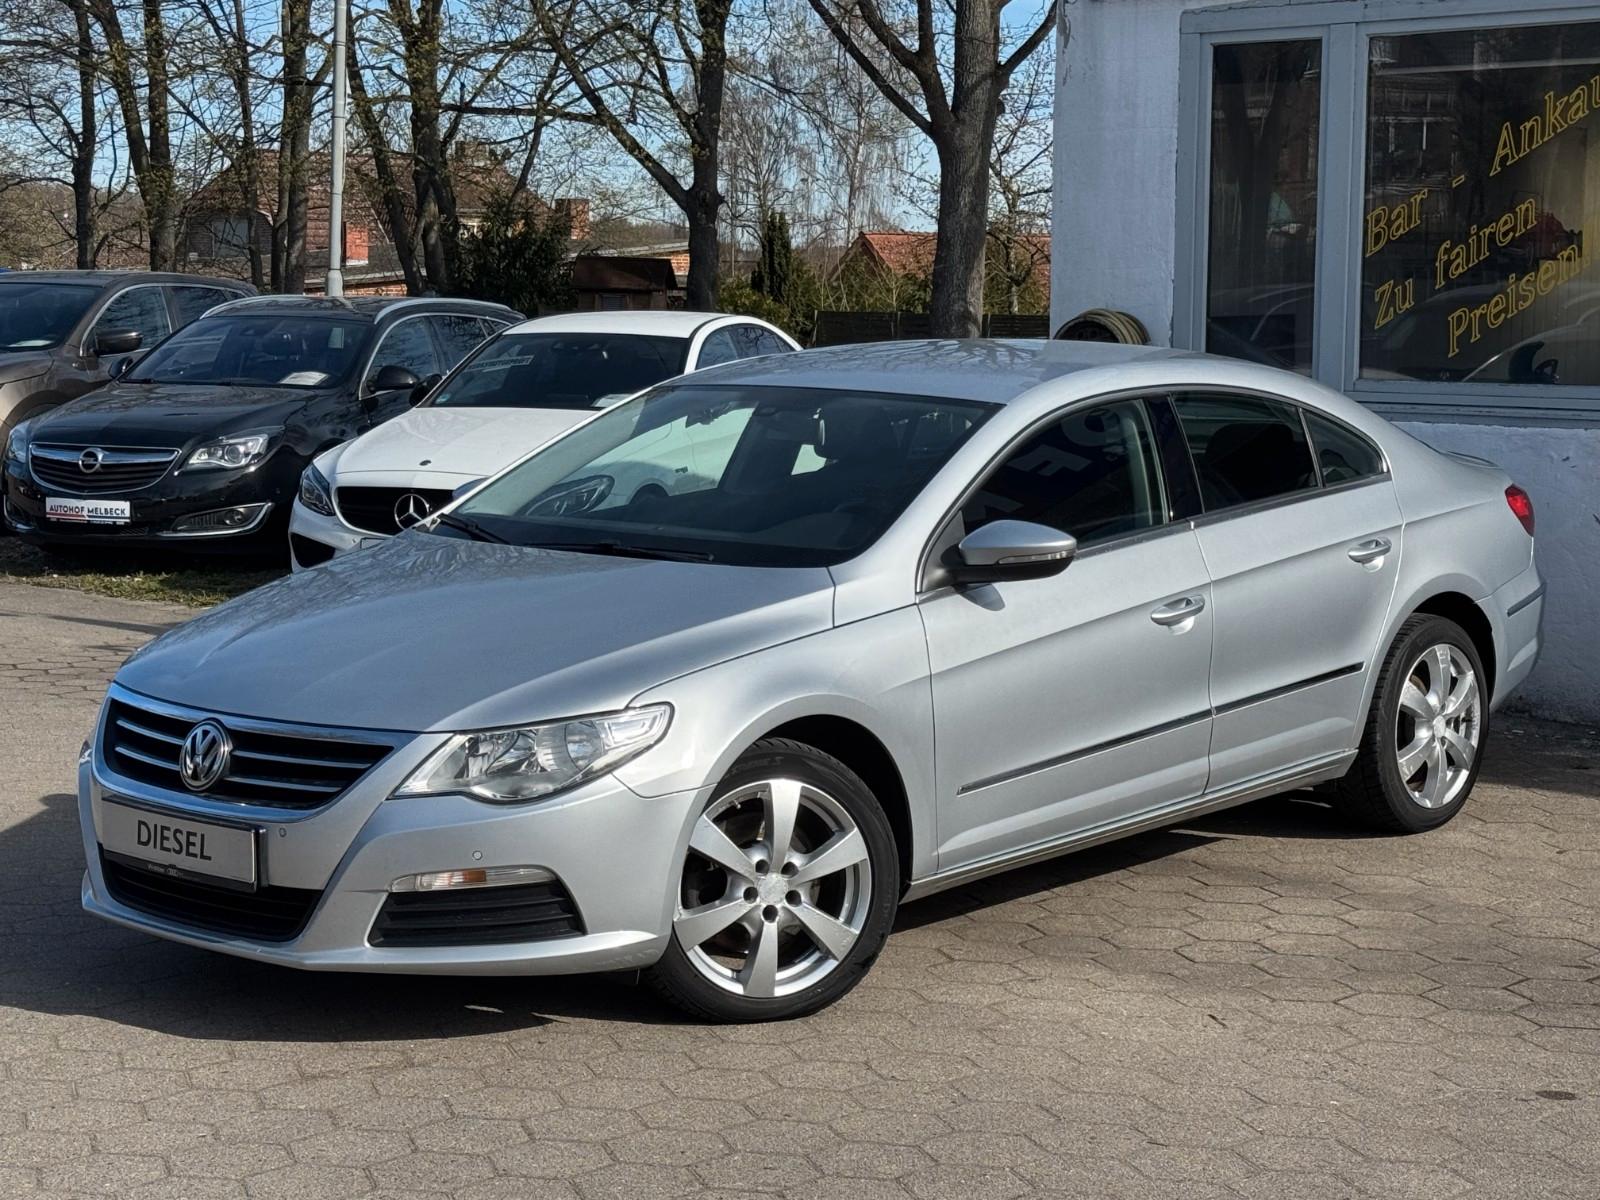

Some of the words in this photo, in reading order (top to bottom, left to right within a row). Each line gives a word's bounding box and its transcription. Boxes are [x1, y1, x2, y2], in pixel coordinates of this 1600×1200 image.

[1365, 188, 1428, 258] Bar
[1374, 278, 1415, 330] Zu
[1434, 198, 1537, 290] fairen
[49, 504, 85, 514] AUTOHOF
[87, 506, 126, 516] MELBECK
[137, 819, 212, 861] DIESEL
